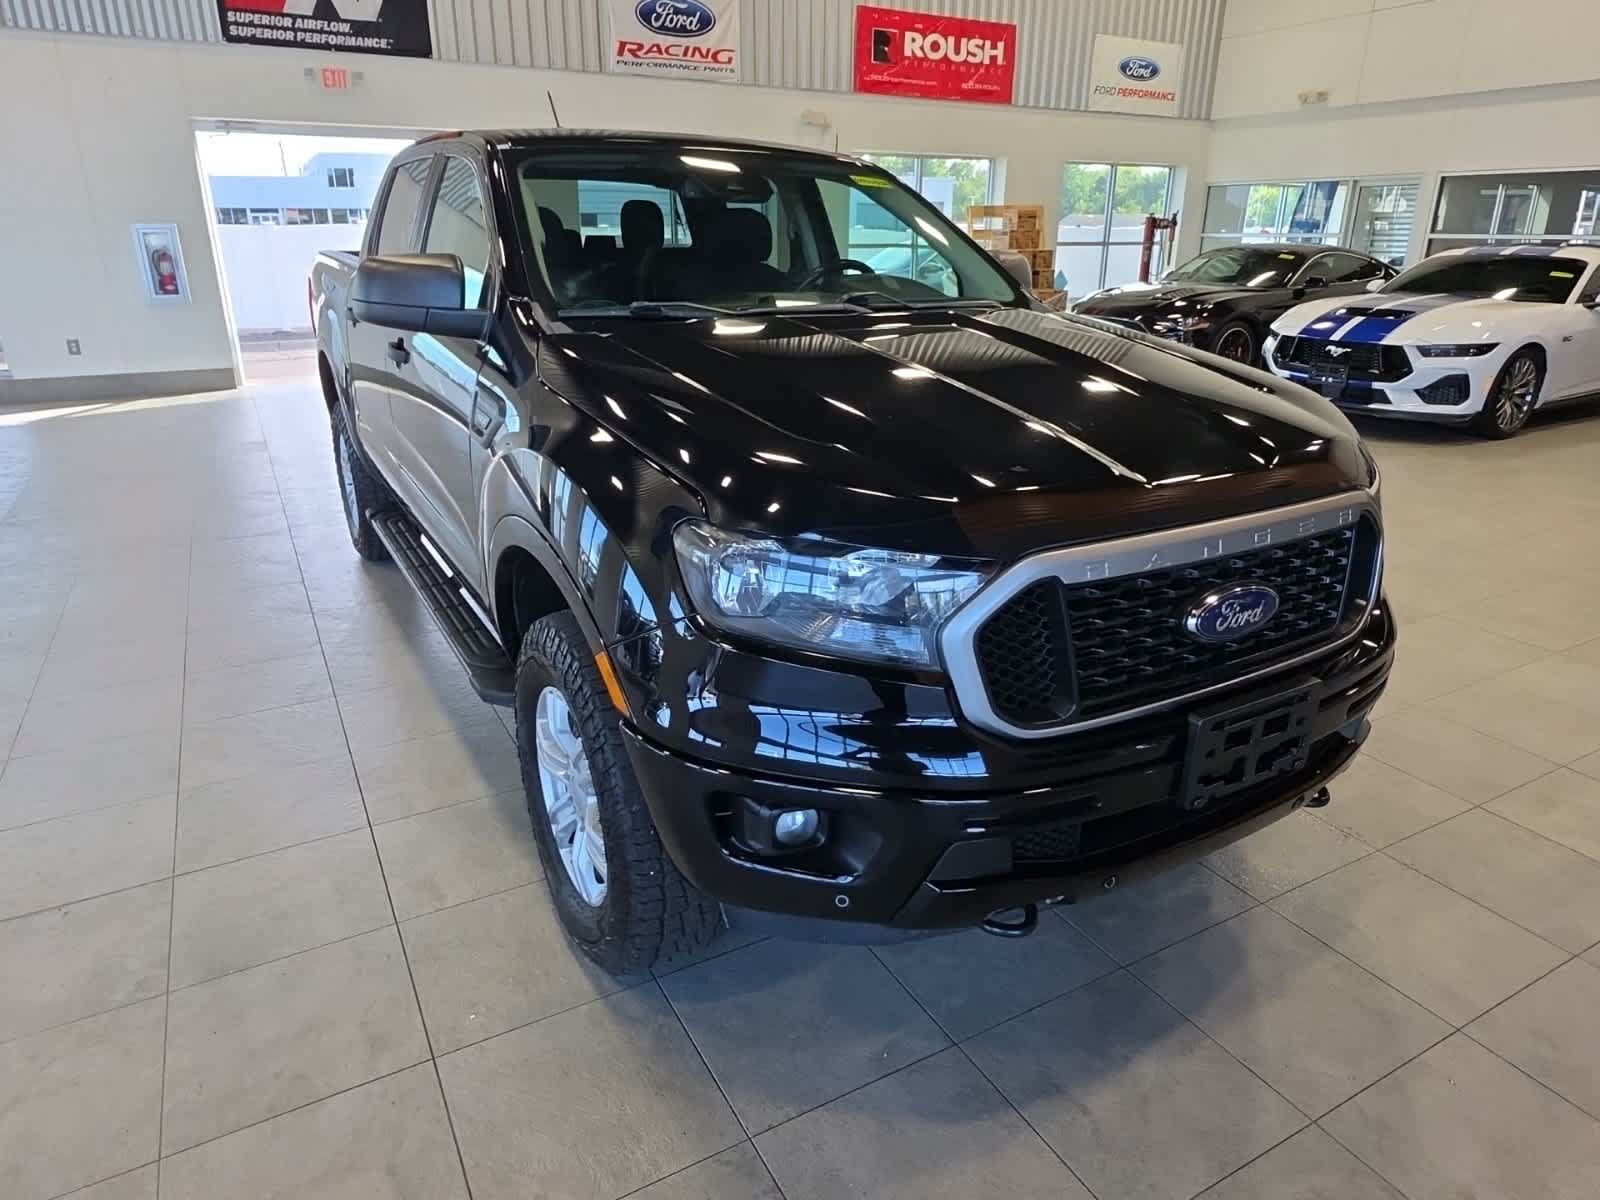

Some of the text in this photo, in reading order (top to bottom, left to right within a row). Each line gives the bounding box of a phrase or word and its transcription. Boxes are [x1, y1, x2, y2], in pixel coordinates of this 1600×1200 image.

[226, 11, 353, 34] SUPERIOR AIRFLOW.
[651, 0, 701, 31] Ford
[229, 25, 294, 42] SUPERIOR
[616, 40, 735, 64] RACING
[903, 31, 1005, 65] ROUSH
[616, 59, 736, 74] PERFORMANCE PARTS
[1126, 59, 1153, 77] Ford
[321, 68, 348, 89] EXIT
[1094, 85, 1176, 102] FORD PERFORMANCE
[1215, 599, 1264, 632] Ford
